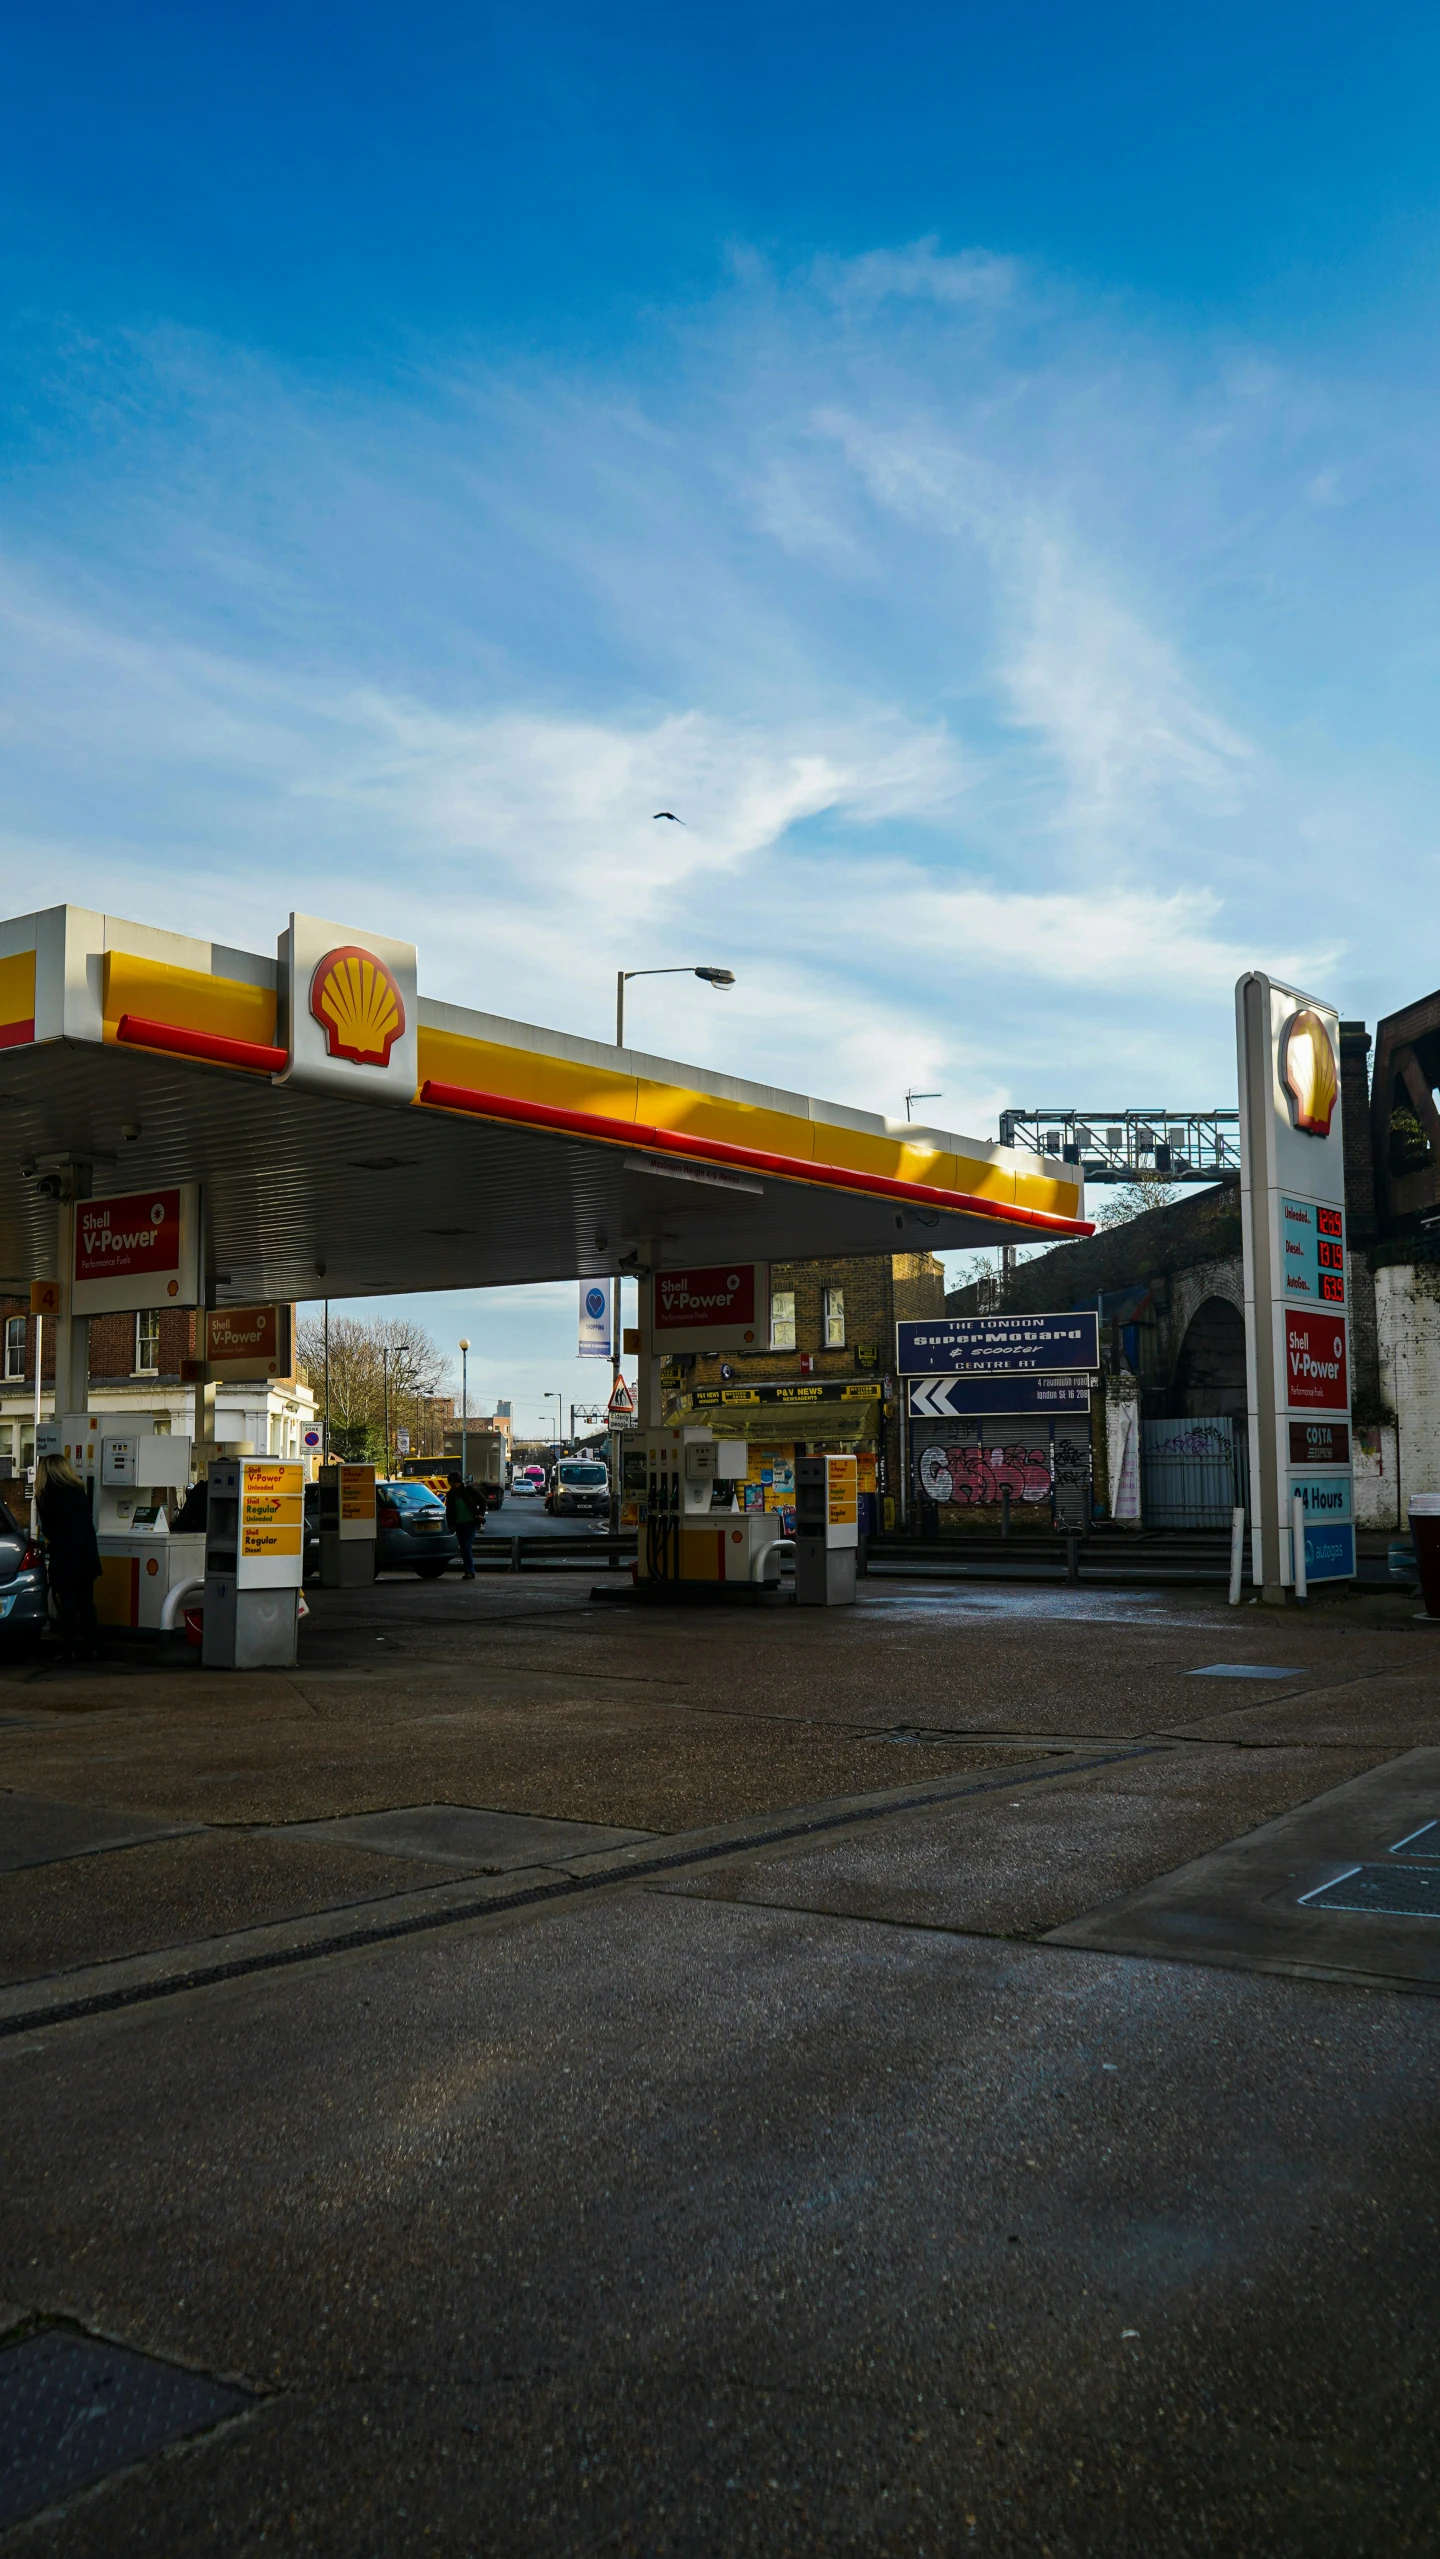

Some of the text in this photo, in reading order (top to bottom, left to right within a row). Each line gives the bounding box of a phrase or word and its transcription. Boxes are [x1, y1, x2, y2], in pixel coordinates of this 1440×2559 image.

[650, 1160, 682, 1172] Maximum
[684, 1166, 704, 1177] Height
[718, 1172, 740, 1183] Metres
[82, 1211, 110, 1230] Shell
[1285, 1206, 1308, 1223] Unleaded
[83, 1229, 158, 1254] V-Power
[1286, 1240, 1301, 1255] Diesel
[82, 1256, 130, 1268] Performance Fuels
[661, 1279, 688, 1292] Shell
[1287, 1274, 1307, 1290] AutoGas
[42, 1290, 54, 1307] 4
[662, 1292, 734, 1310] V-Power
[661, 1312, 694, 1320] Performance
[212, 1319, 230, 1331] Shell
[948, 1319, 1044, 1330] THE LONDON
[212, 1331, 262, 1345] V-Power
[632, 1334, 640, 1348] 2
[1290, 1331, 1308, 1350] Shell
[970, 1345, 1044, 1356] scooter
[955, 1360, 1038, 1370] CENTRE AT
[1290, 1352, 1339, 1379] V-Power
[1038, 1378, 1042, 1387] 4
[1074, 1377, 1088, 1386] road
[776, 1387, 823, 1396] P&V NEWS
[1036, 1390, 1057, 1400] london
[1068, 1390, 1074, 1398] 16
[1291, 1385, 1324, 1397] Performance Fuels
[611, 1412, 629, 1420] Elderly
[1306, 1427, 1332, 1445] COSTA
[1314, 1448, 1332, 1458] EXPRESS
[248, 1474, 282, 1482] V-Power
[1312, 1488, 1342, 1509] Hours
[247, 1505, 278, 1515] Regular
[245, 1536, 277, 1546] Regular
[1316, 1544, 1343, 1561] autogas
